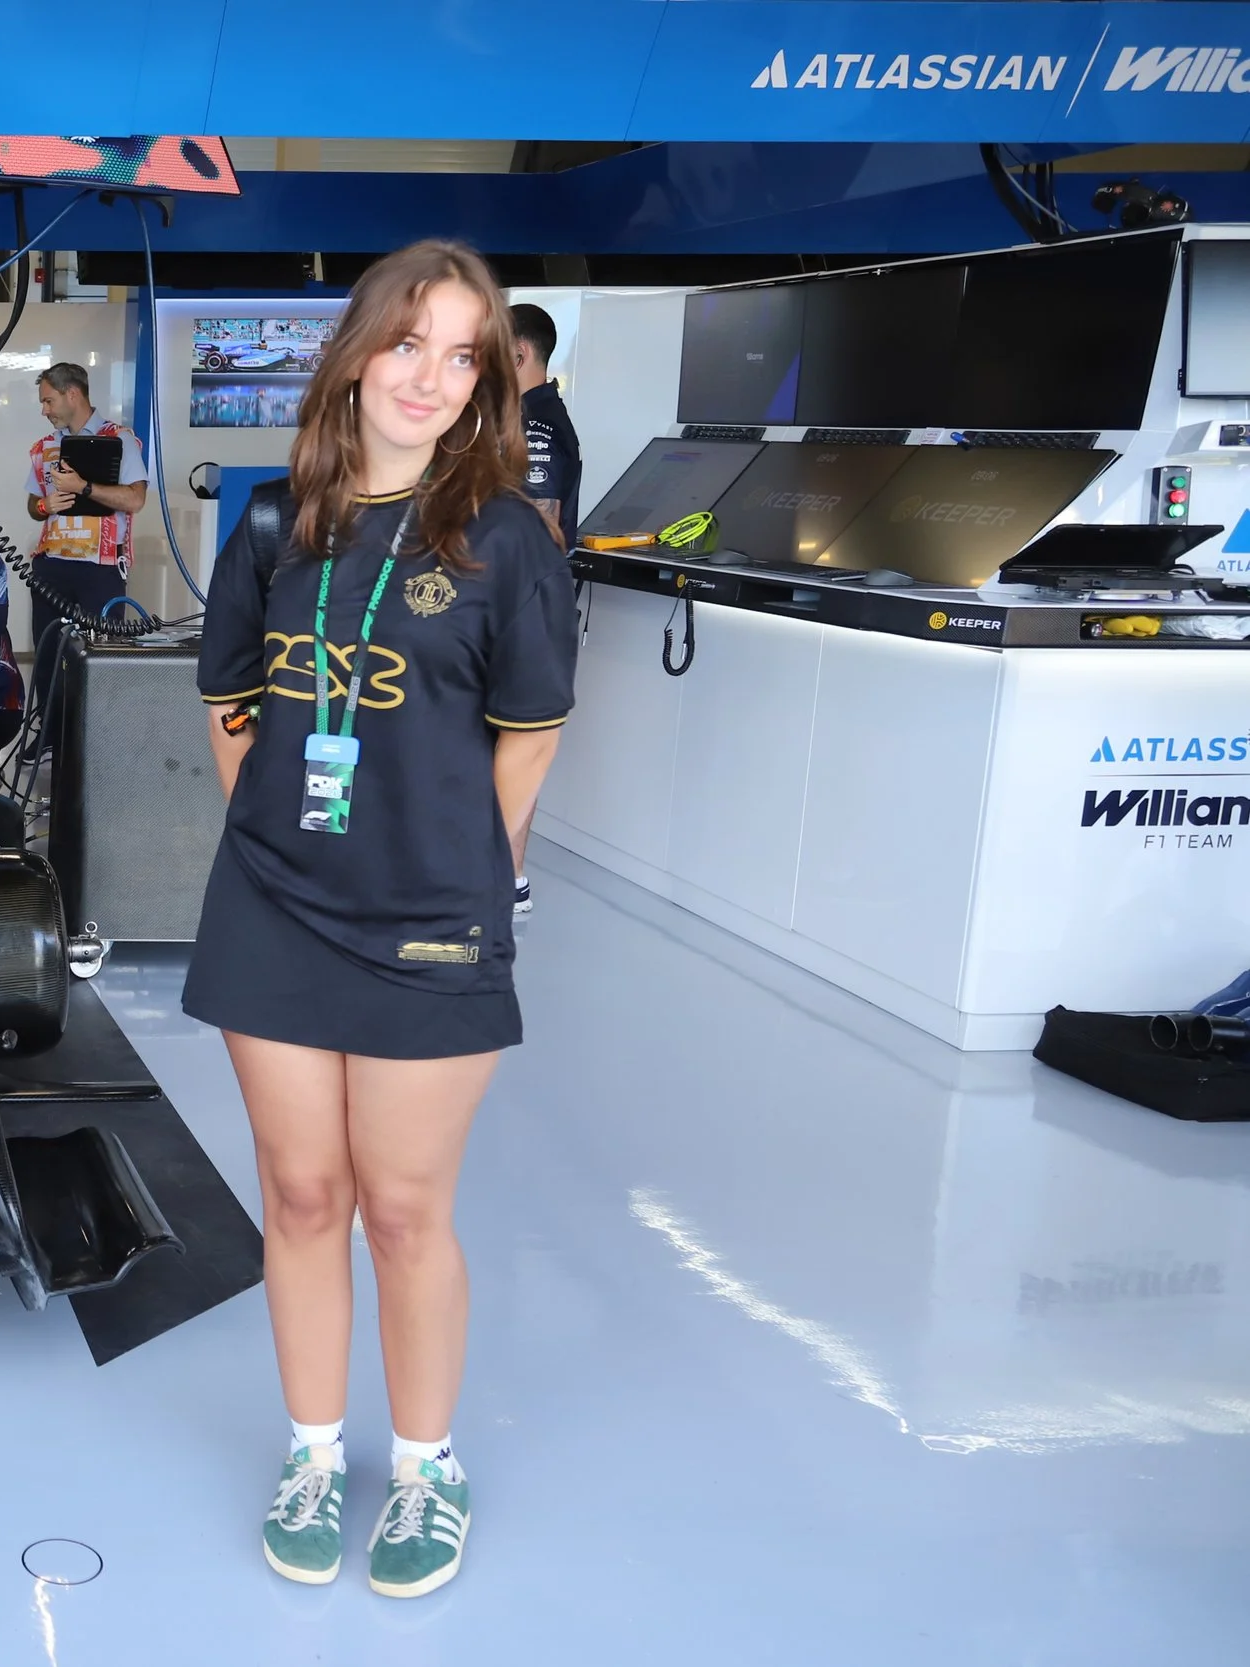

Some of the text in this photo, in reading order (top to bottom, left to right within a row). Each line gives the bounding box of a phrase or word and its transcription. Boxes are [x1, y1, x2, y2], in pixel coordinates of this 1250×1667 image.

[794, 54, 1068, 91] ATLASSIAN
[761, 491, 842, 513] KEEPER
[914, 501, 1017, 526] KEEPER
[319, 558, 332, 608] PADDOCK
[368, 557, 396, 611] PADDOCK
[949, 617, 1002, 631] KEEPER
[317, 673, 327, 707] 2026
[348, 676, 359, 711] 2026
[1121, 737, 1249, 762] ATLASS
[308, 788, 342, 798] 2026
[1144, 833, 1234, 849] F1 TEAM
